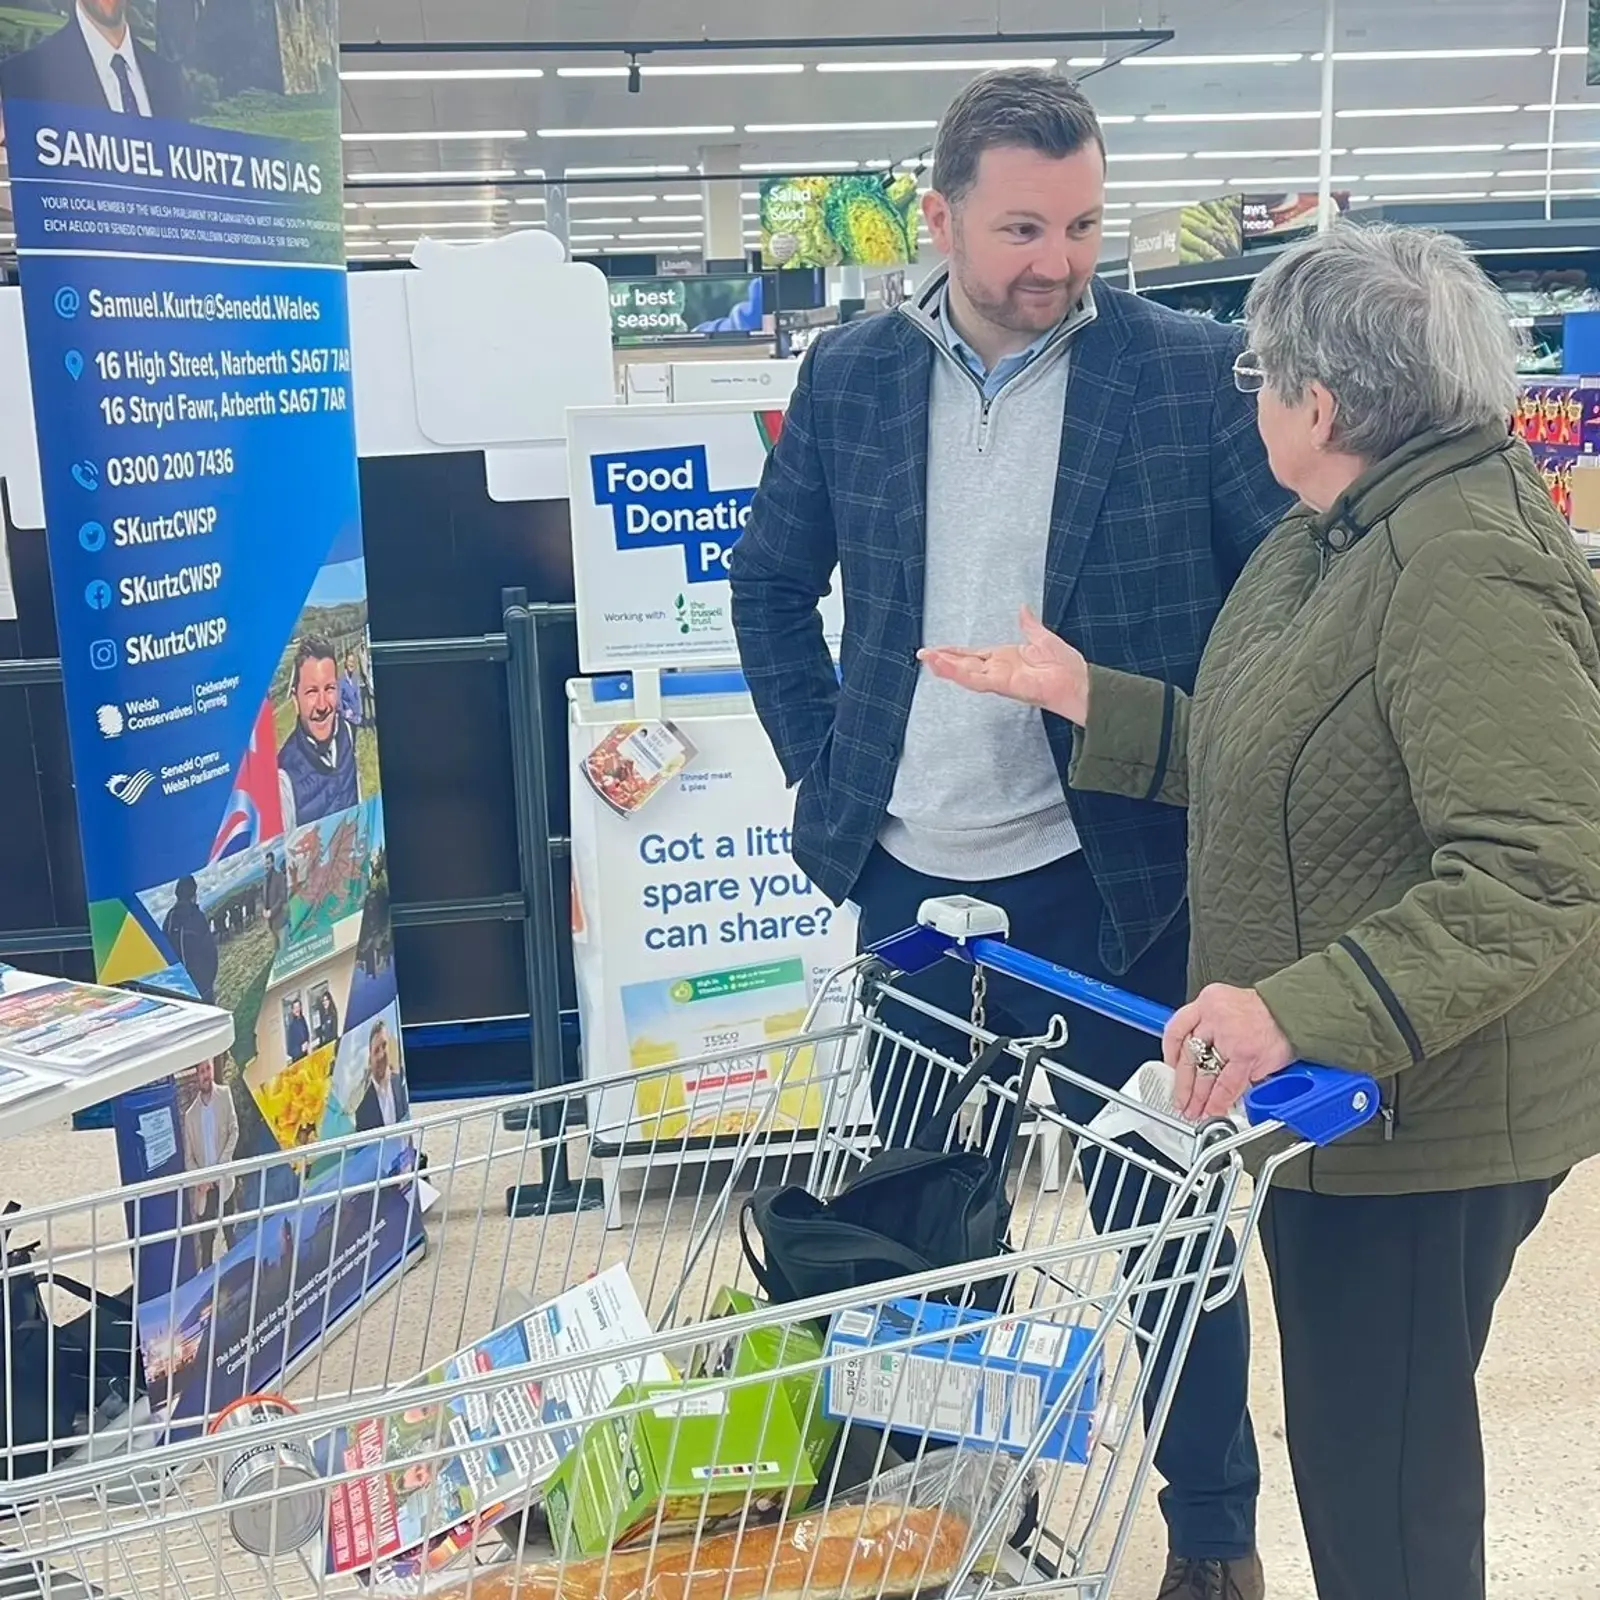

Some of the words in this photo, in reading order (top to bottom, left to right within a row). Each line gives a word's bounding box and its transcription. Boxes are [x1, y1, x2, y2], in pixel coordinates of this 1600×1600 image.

[36, 127, 163, 177] SAMUEL
[168, 144, 246, 187] KURTZ
[41, 196, 69, 210] YOUR
[70, 198, 97, 212] LOCAL
[1243, 205, 1269, 218] aws,
[44, 219, 67, 232] EICH
[69, 220, 97, 233] AELOD
[1243, 219, 1274, 230] heese
[88, 289, 321, 321] Samuel.Kurtz@Senedd.Wales
[610, 293, 631, 308] ur
[635, 289, 676, 307] best
[617, 313, 681, 329] season
[95, 350, 119, 380] 16
[125, 351, 166, 385] High
[169, 350, 219, 380] Street,
[221, 349, 288, 378] Narberth
[290, 348, 330, 374] SA67
[100, 398, 125, 425] 16
[131, 395, 173, 429] Stryd
[178, 394, 219, 423] Fawr,
[221, 390, 277, 418] Arberth
[278, 388, 319, 414] SA67
[320, 387, 347, 411] 7AR
[107, 455, 159, 488] 0300
[162, 451, 195, 483] 200
[198, 447, 234, 475] 7436
[607, 459, 693, 493] Food
[113, 505, 218, 547] SKurtzCWSP
[626, 499, 752, 535] Donatio
[700, 542, 734, 573] Po
[119, 562, 222, 607] SKurtzCWSP
[604, 611, 644, 623] Working
[645, 610, 667, 620] with
[690, 601, 706, 610] the
[690, 607, 723, 618] trussell
[690, 617, 712, 625] trust
[125, 616, 228, 666] SKurtzCWSP
[125, 697, 161, 715] Welsh
[196, 692, 228, 714] Cymreig
[127, 704, 194, 731] Conservatives
[160, 759, 194, 779] Senedd
[194, 751, 220, 770] Cymru
[711, 771, 732, 779] meat
[162, 775, 190, 796] Welsh
[190, 763, 231, 786] Parliament
[689, 784, 706, 792] pies
[639, 832, 705, 864] Got
[715, 835, 735, 858] a
[747, 825, 793, 857] litt
[642, 877, 740, 915] spare
[749, 874, 812, 906] you
[645, 922, 707, 950] can
[719, 906, 833, 944] share?
[703, 1031, 739, 1044] TESCO
[359, 1420, 384, 1471] OSPITAL
